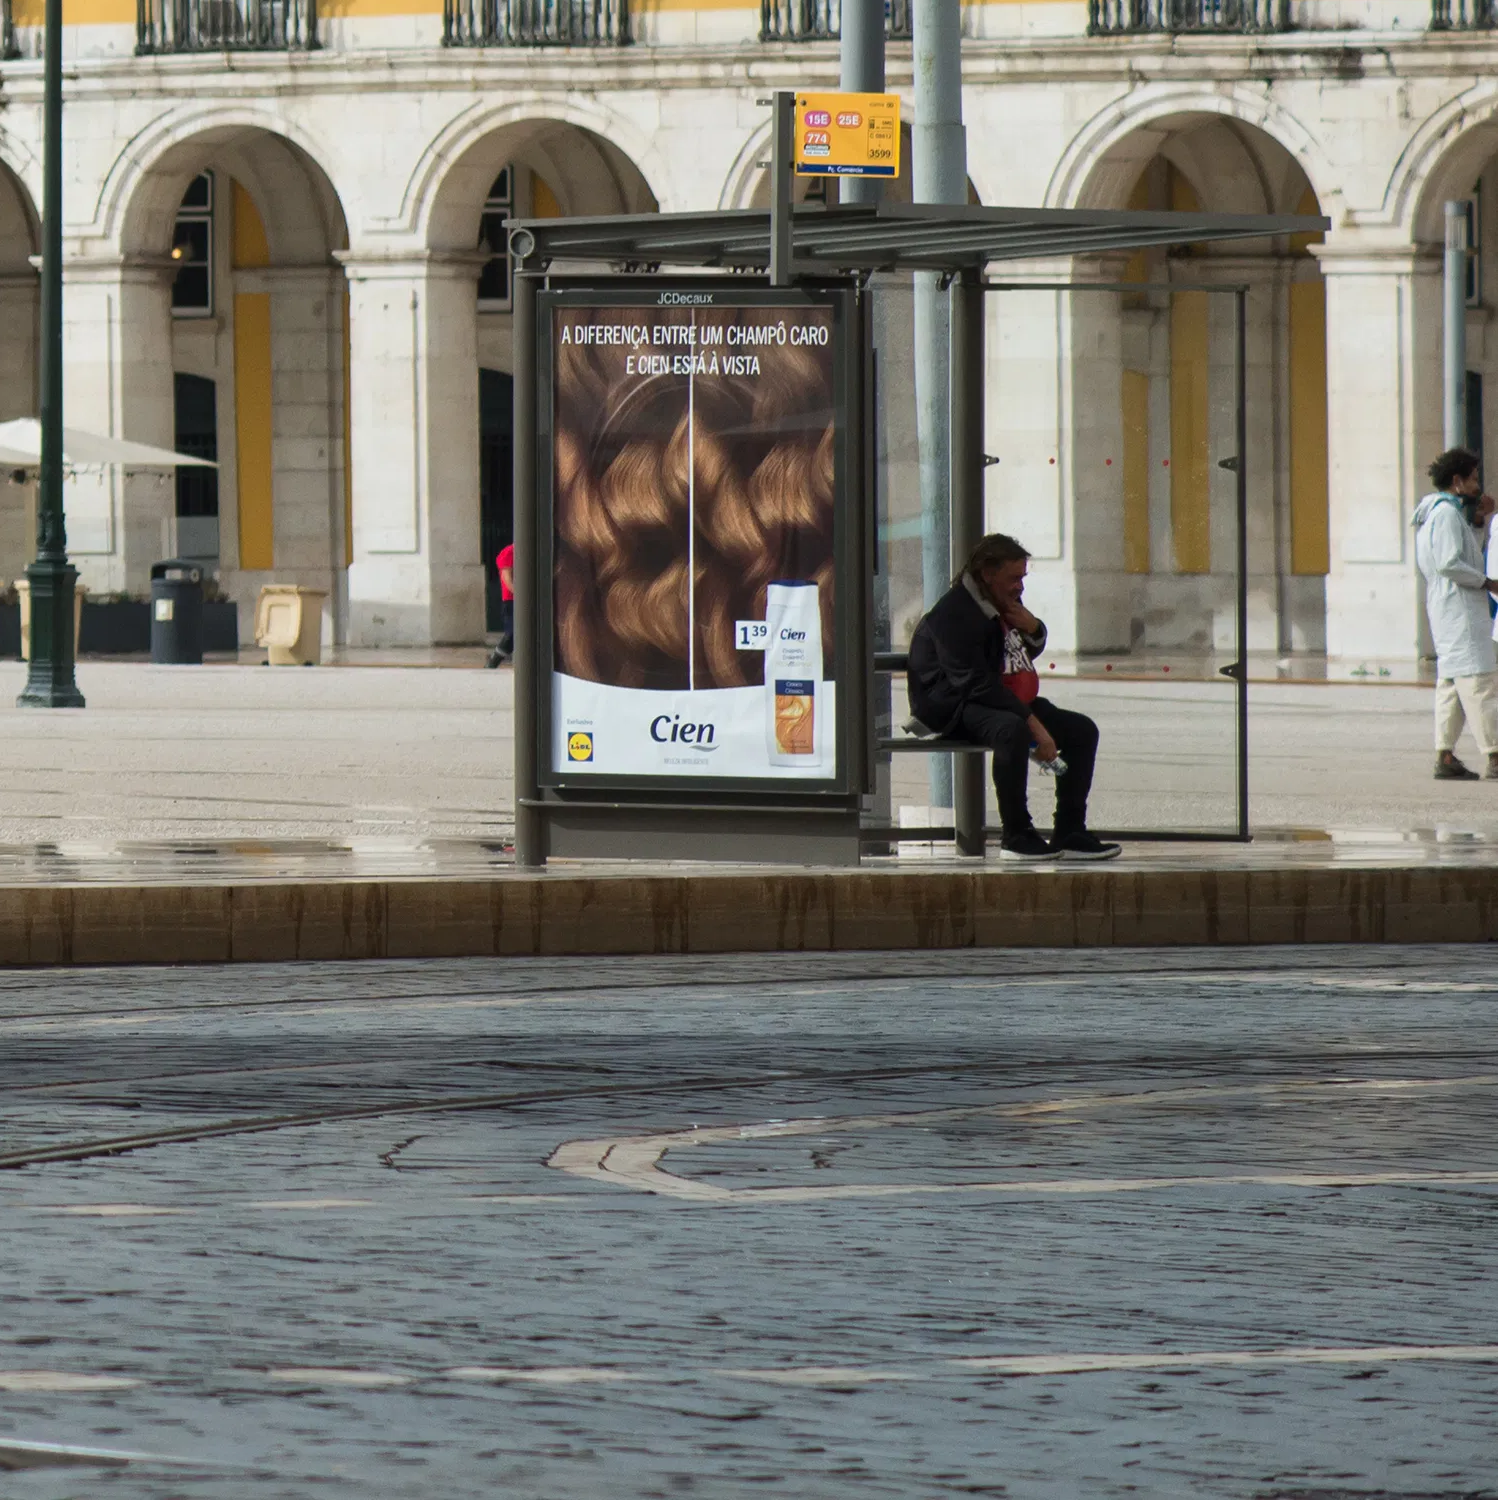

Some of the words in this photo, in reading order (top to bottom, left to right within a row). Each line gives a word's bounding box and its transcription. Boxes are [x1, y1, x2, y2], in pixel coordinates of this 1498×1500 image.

[808, 114, 828, 125] 15E
[838, 115, 859, 126] 25E
[807, 133, 827, 143] 774
[869, 149, 891, 158] 3599
[657, 293, 713, 304] JCDecaux
[561, 326, 571, 344] A
[575, 325, 649, 349] DIFERENÇA
[653, 326, 697, 344] ENTRE
[700, 326, 722, 345] UM
[727, 321, 786, 345] CHAMPÔ
[790, 326, 828, 345] CARO
[626, 355, 635, 374] E
[638, 355, 670, 374] CIEN
[673, 351, 706, 375] ESTÁ
[709, 350, 719, 375] À
[722, 356, 760, 375] VISTA
[780, 628, 806, 641] Cien
[650, 714, 715, 743] Cien
